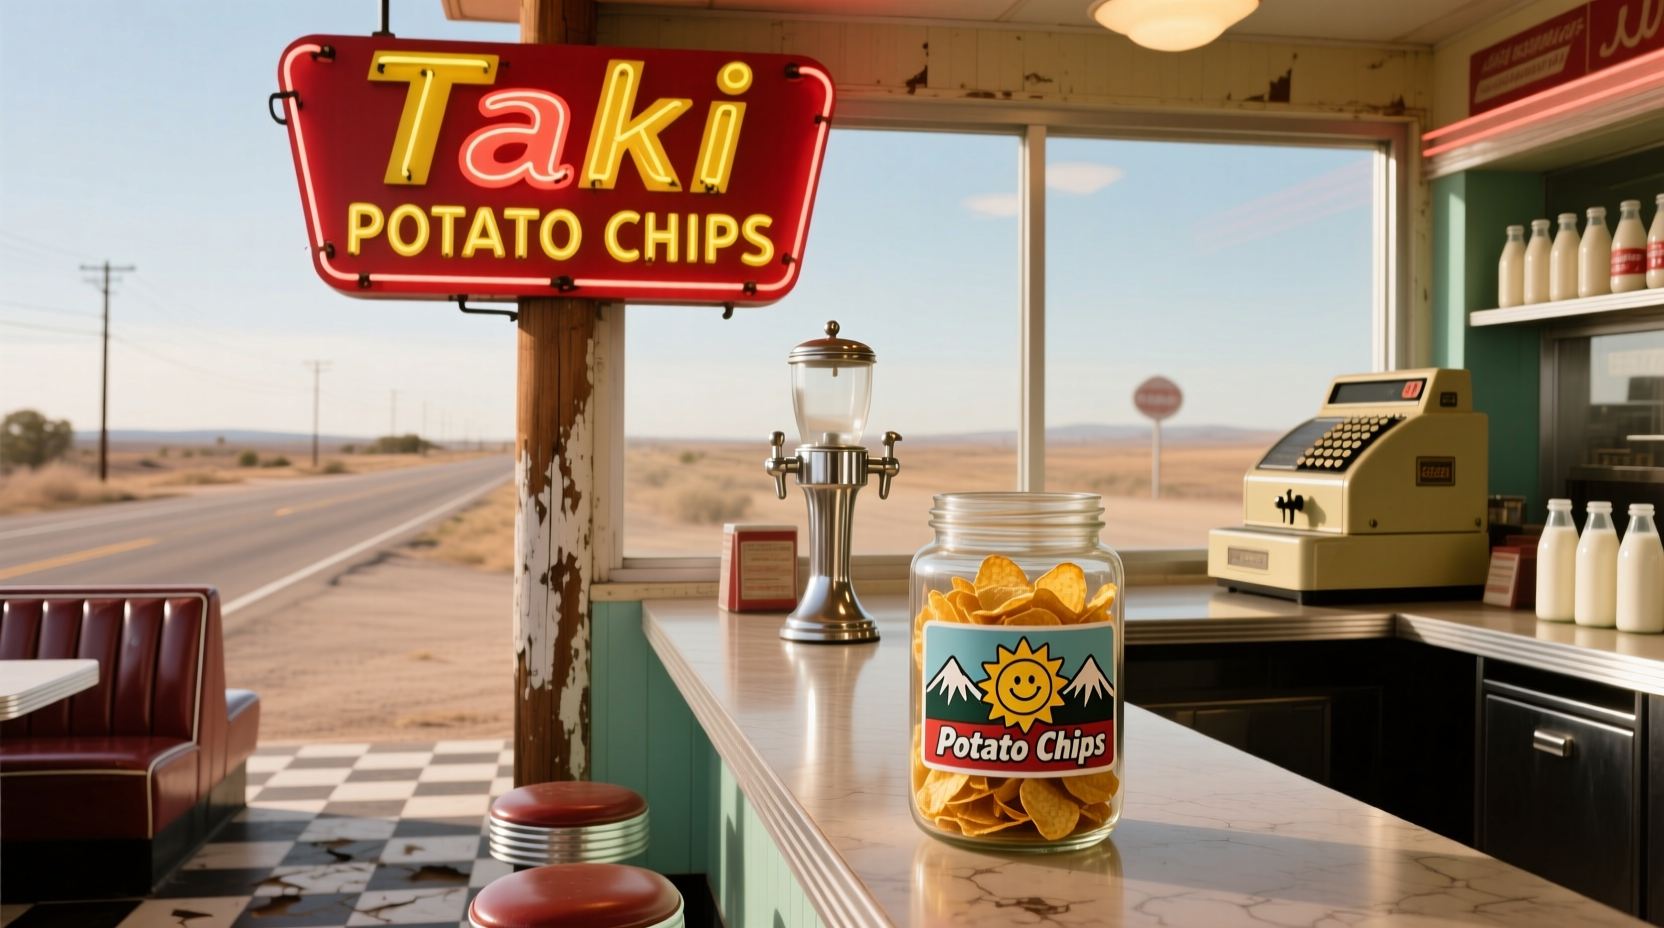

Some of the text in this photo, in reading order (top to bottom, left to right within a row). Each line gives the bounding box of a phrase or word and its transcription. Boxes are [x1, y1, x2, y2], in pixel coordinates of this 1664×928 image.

[367, 50, 753, 193] Taki
[347, 203, 775, 266] POTATO CHIPS
[936, 726, 1106, 765] Potato Chips
